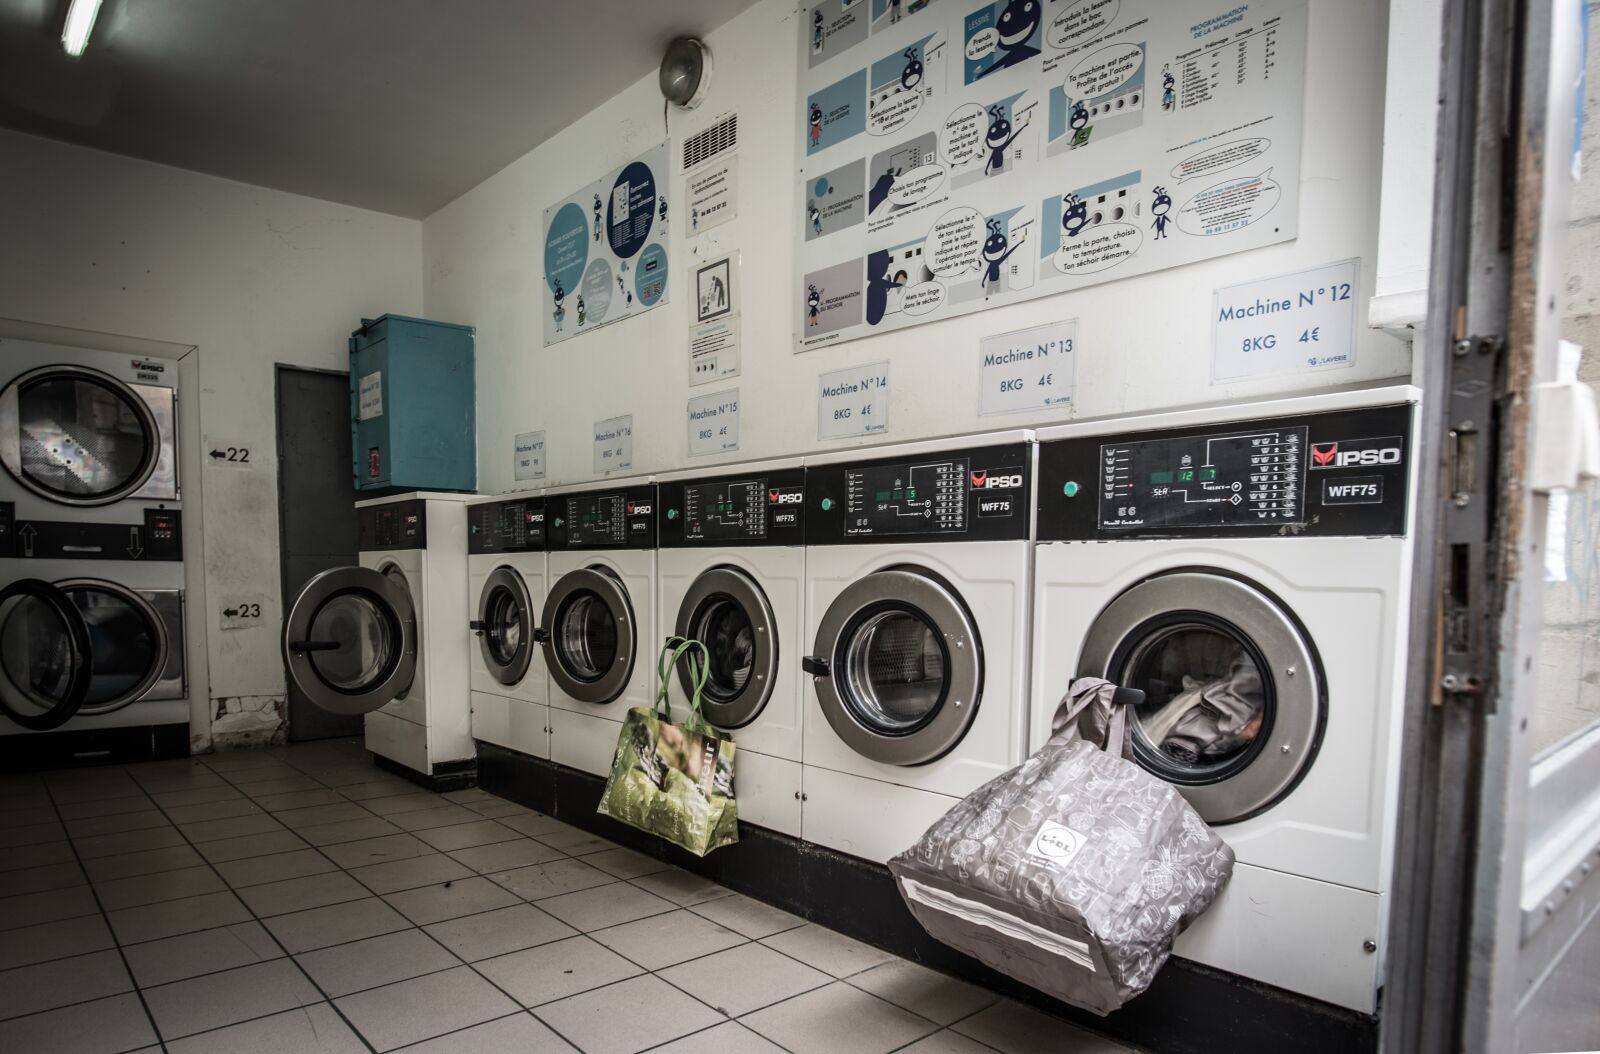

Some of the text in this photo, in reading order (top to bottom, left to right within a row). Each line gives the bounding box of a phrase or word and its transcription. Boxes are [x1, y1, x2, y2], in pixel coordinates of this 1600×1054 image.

[968, 12, 990, 30] LESSIVE
[1054, 11, 1081, 27] Introduis
[1064, 22, 1080, 32] dans
[1089, 12, 1101, 21] bac
[1190, 5, 1248, 32] PROGRAMMATION
[1213, 15, 1243, 31] MACHINE
[972, 33, 992, 46] Prends
[1079, 64, 1105, 80] machine
[1107, 59, 1117, 67] est
[1076, 71, 1107, 89] Profite de
[1084, 85, 1096, 95] wifi
[1097, 77, 1120, 92] gratuit
[870, 104, 897, 120] Sélectionne
[946, 114, 976, 130] Sélectionne
[948, 145, 960, 154] paie
[967, 136, 979, 146] tarif
[949, 132, 971, 144] machine
[925, 154, 933, 163] 13
[953, 148, 973, 160] indiqué
[915, 171, 943, 186] programme
[828, 194, 863, 210] PROGRAMMATION
[935, 218, 964, 232] Sélectionne
[941, 239, 953, 248] paie
[960, 231, 971, 240] tarif
[1062, 242, 1082, 252] Ferme
[1113, 229, 1136, 239] choisis
[935, 247, 953, 256] indiqué
[935, 249, 977, 264] l'opération pour
[933, 264, 953, 273] cumuler
[1076, 257, 1099, 267] séchoir
[825, 291, 860, 304] PROGRAMMATION
[927, 288, 939, 297] linge
[1219, 299, 1291, 322] Machine
[1242, 327, 1320, 352] 8KG 4€
[984, 349, 1033, 367] Machine
[822, 383, 857, 398] Machine
[1000, 374, 1052, 392] 8KG 4€
[690, 408, 717, 420] Machine
[834, 404, 871, 420] 8KG 4€
[699, 429, 712, 439] 8KG
[227, 447, 249, 463] 22
[1336, 448, 1400, 466] IPSO
[985, 475, 1022, 488] IPSO
[1181, 472, 1193, 480] 12
[1329, 484, 1376, 497] WFF75
[778, 493, 803, 504] IPSO
[634, 506, 651, 514] IPSO
[982, 502, 1010, 511] WFF75
[239, 604, 260, 618] 23
